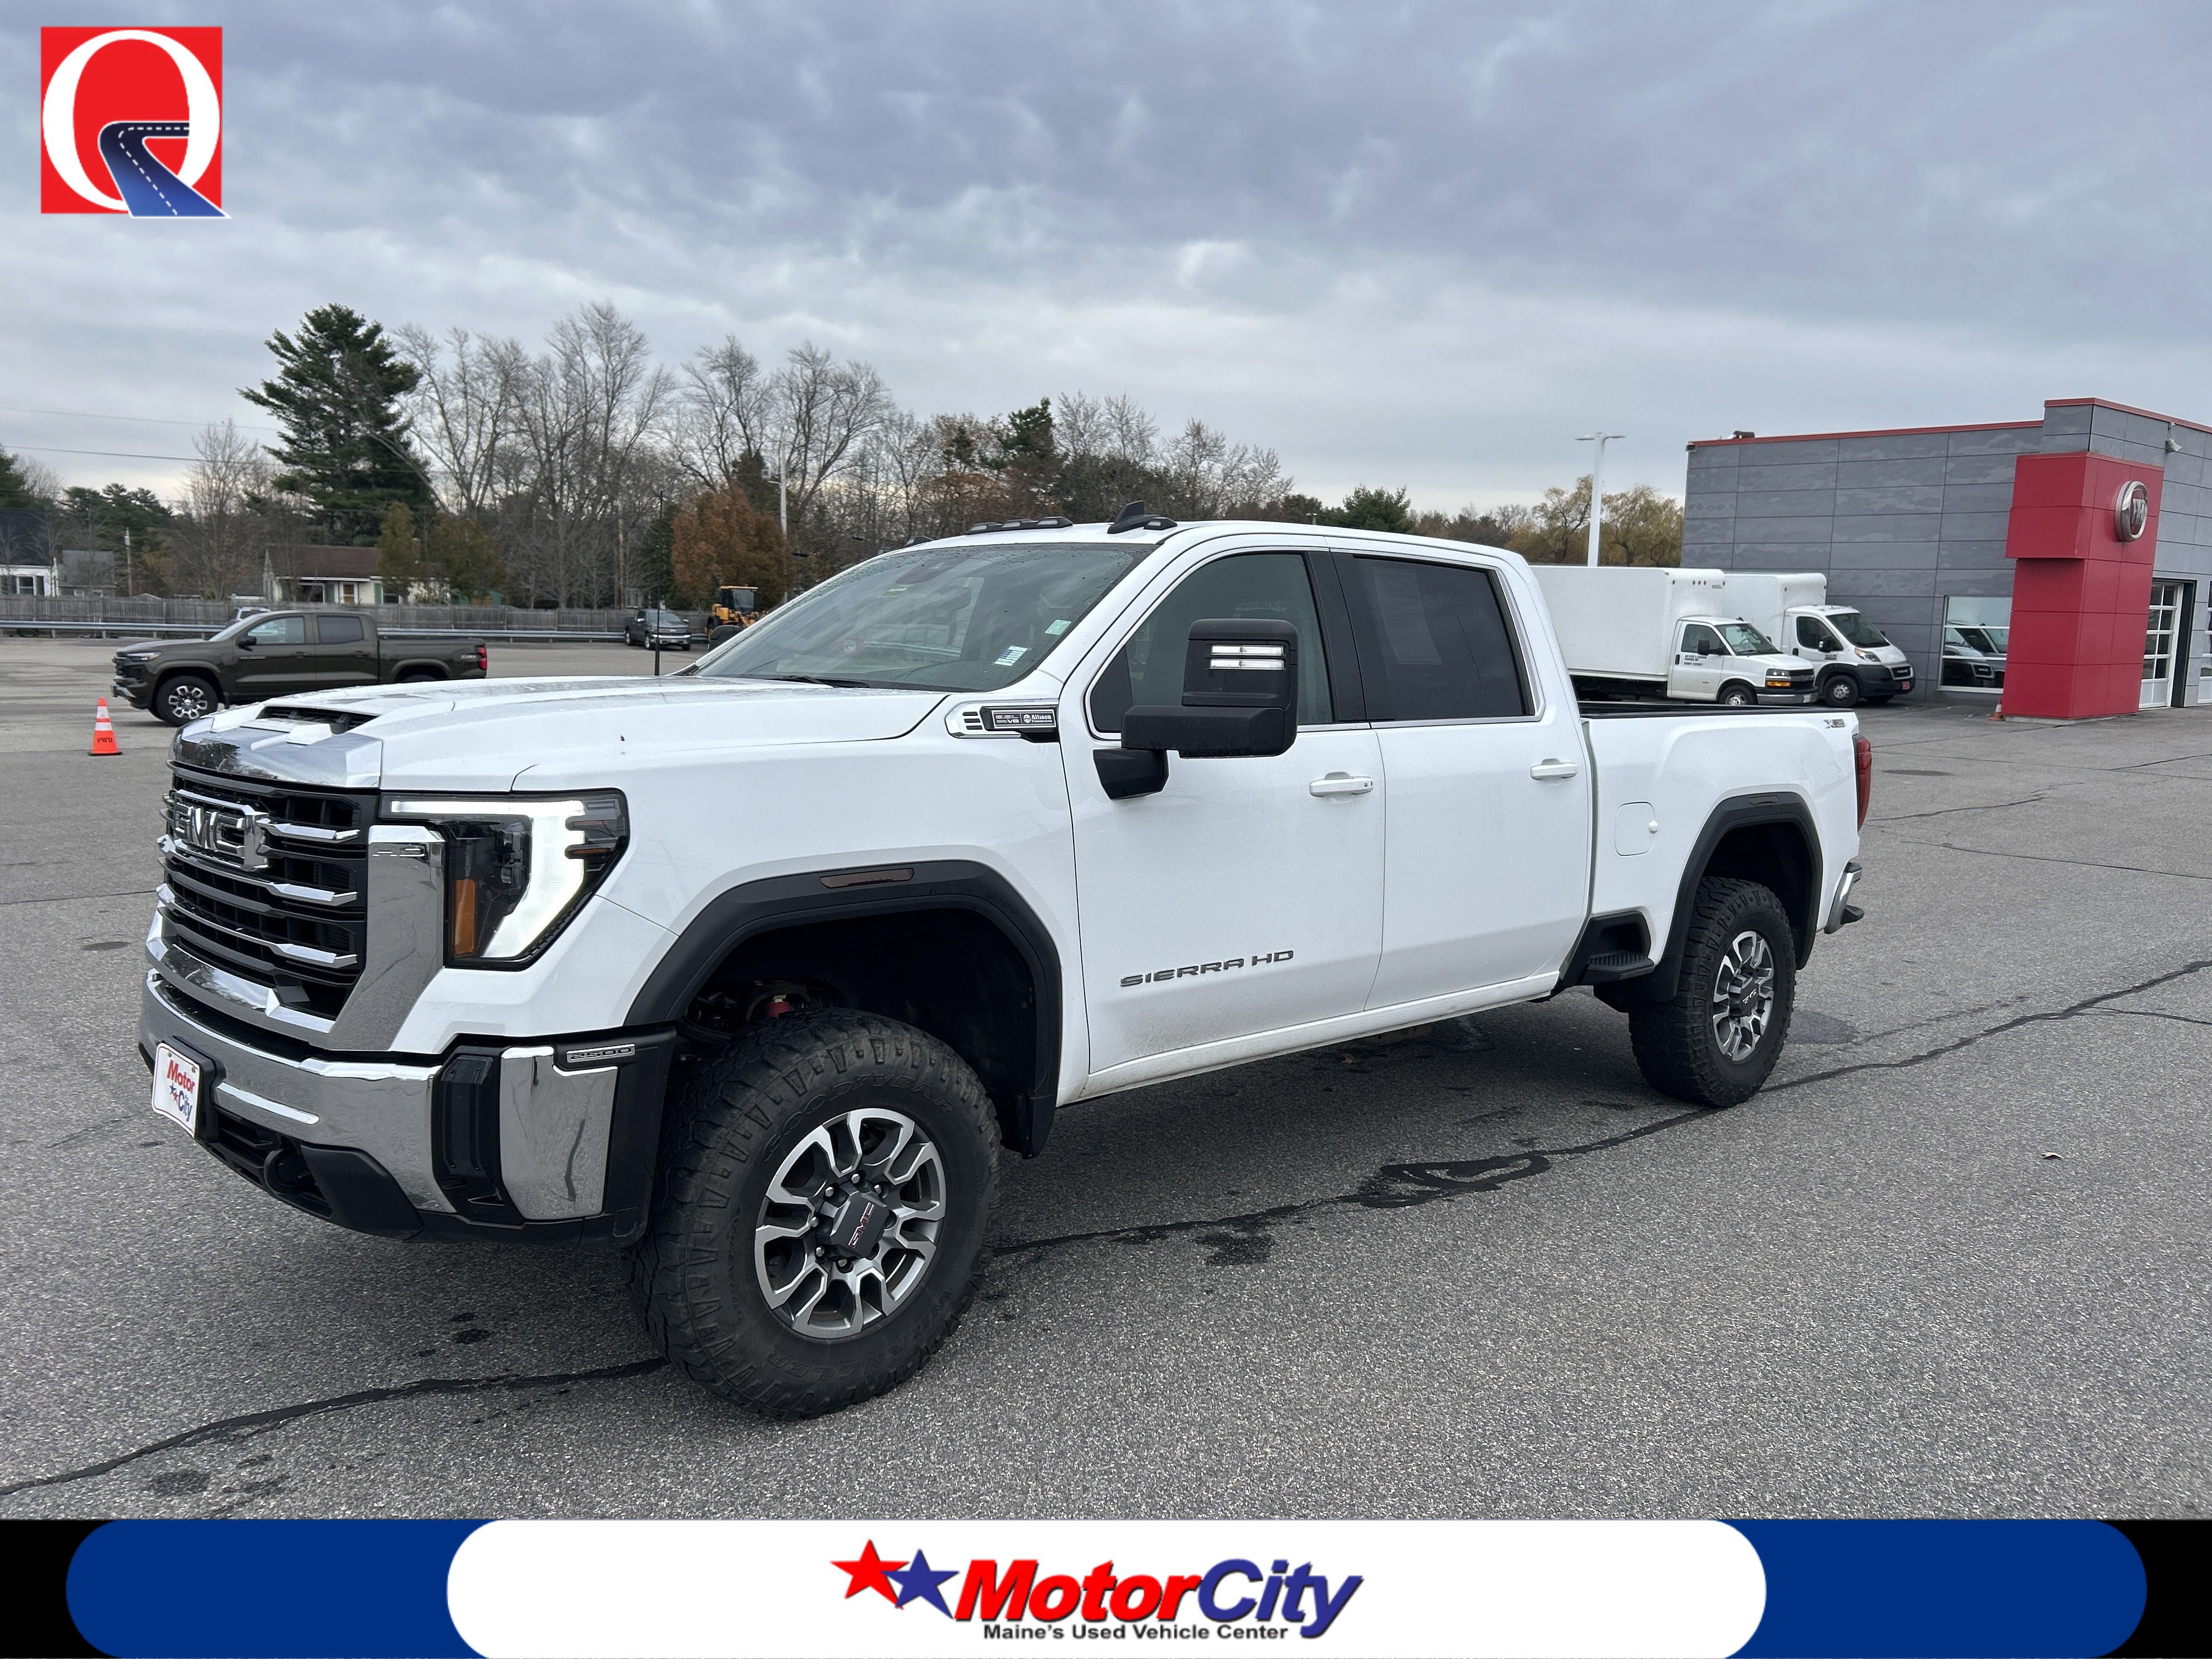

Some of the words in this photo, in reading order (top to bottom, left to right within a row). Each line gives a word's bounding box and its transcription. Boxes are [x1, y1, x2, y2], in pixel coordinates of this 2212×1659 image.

[1120, 958, 1244, 987] SIERRA
[1251, 950, 1294, 966] HD
[570, 1047, 632, 1060] 2500
[167, 1059, 195, 1093] Motor
[178, 1090, 193, 1122] City
[848, 1202, 874, 1249] GMC
